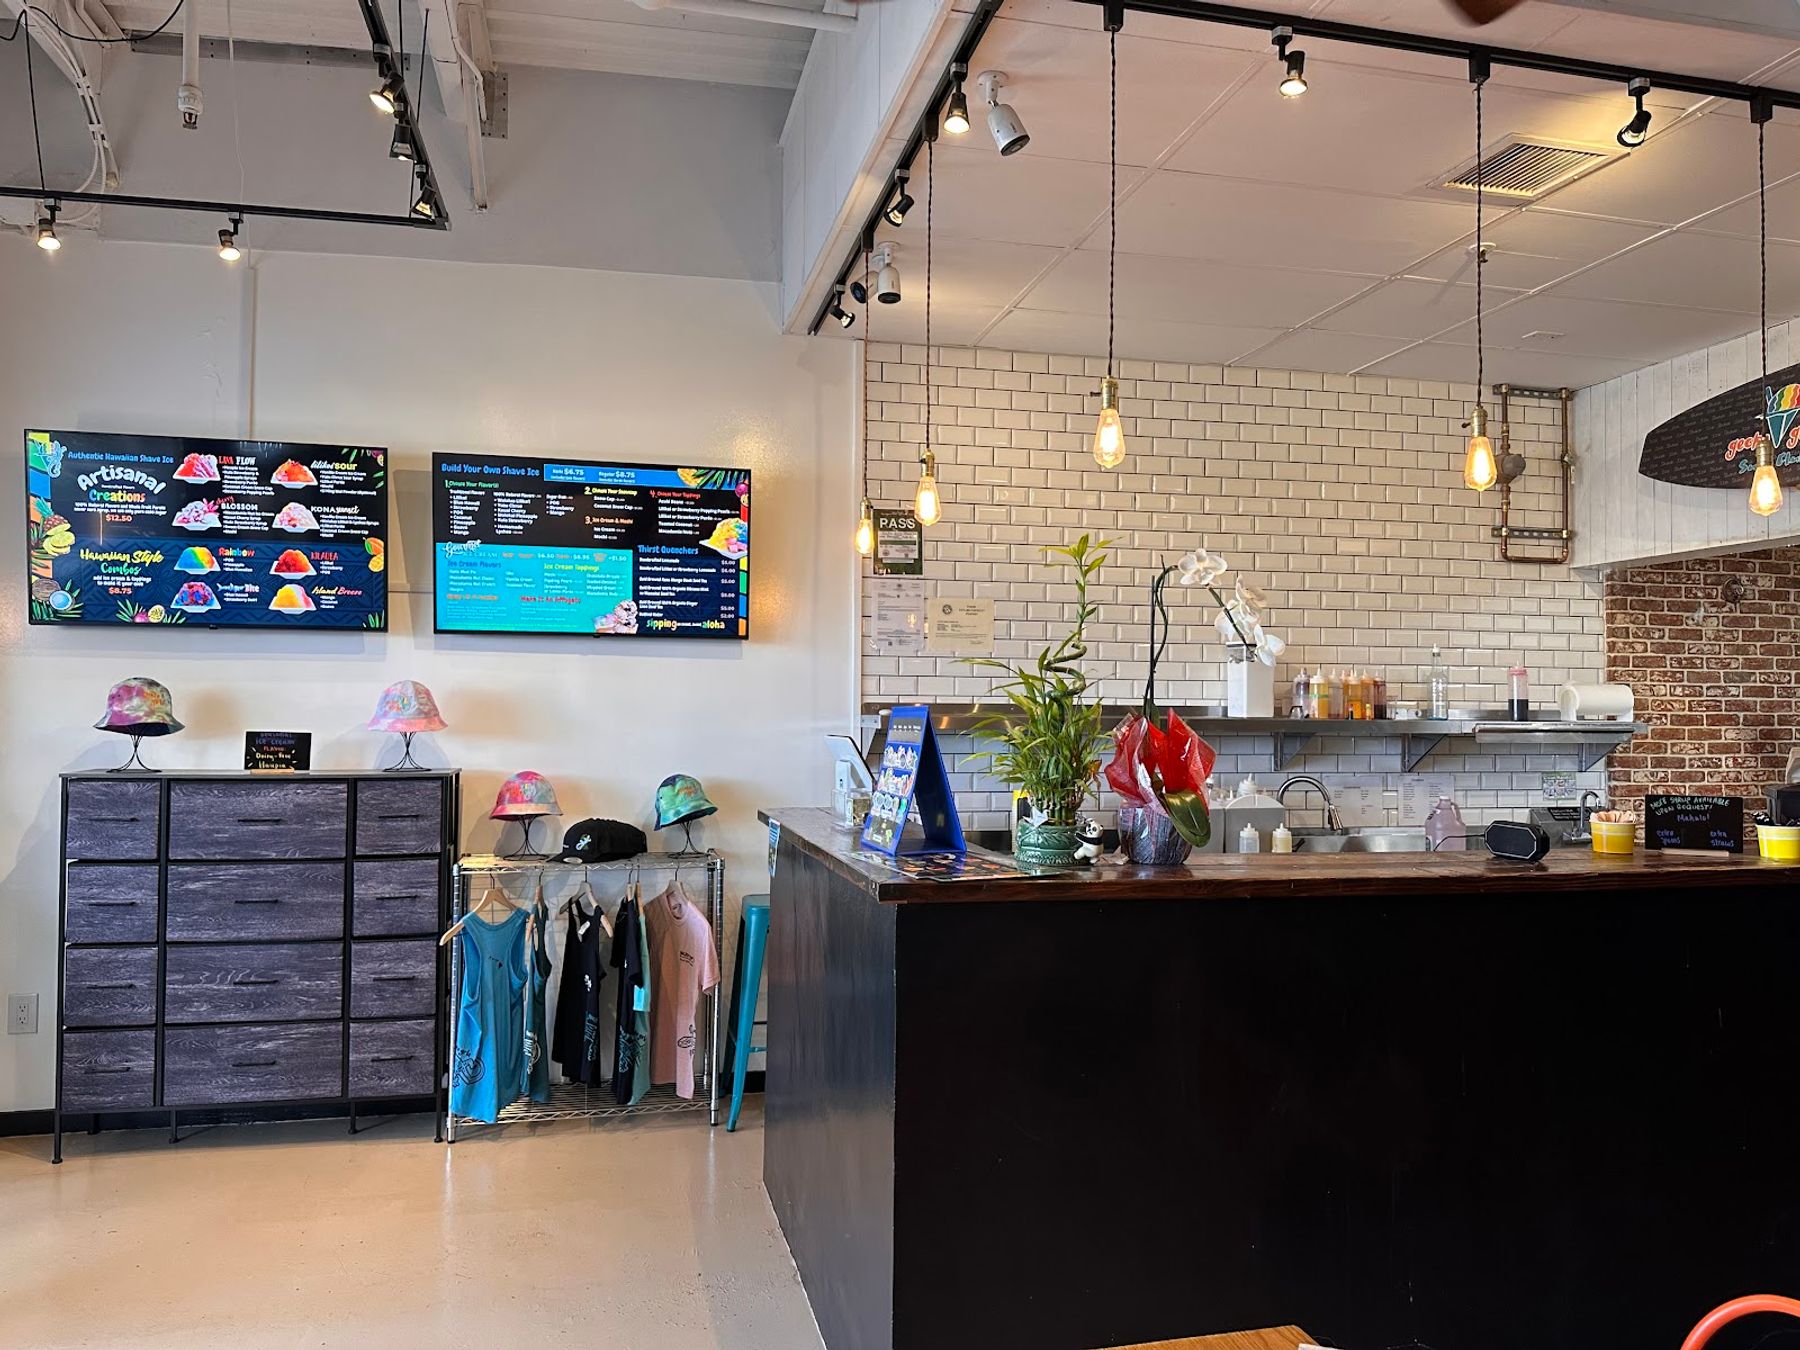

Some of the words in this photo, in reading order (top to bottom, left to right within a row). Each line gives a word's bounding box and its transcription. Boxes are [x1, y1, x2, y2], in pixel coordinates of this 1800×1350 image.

[105, 453, 138, 462] Hawaiian
[140, 454, 160, 462] Shave
[236, 456, 256, 465] FLOW
[441, 464, 461, 472] Build
[463, 464, 481, 473] Your
[483, 466, 500, 474] Own
[502, 466, 525, 476] Shave
[527, 468, 540, 476] Ice
[77, 465, 167, 494] Artisanal
[89, 489, 146, 502] Creations
[584, 486, 592, 495] 2.
[650, 490, 657, 498] 4.
[106, 514, 132, 522] $12.50
[585, 516, 592, 524] 3.
[880, 518, 915, 529] PASS
[218, 547, 255, 557] Rainbow
[638, 545, 660, 553] Thirst
[661, 546, 698, 555] Quenchers
[80, 549, 130, 563] Hawaiian
[132, 550, 164, 567] Style
[101, 563, 141, 575] Combos
[575, 564, 599, 572] Toppings
[312, 586, 338, 594] Island
[337, 587, 362, 595] Breeze
[646, 619, 677, 631] sipping
[702, 619, 725, 629] aloha
